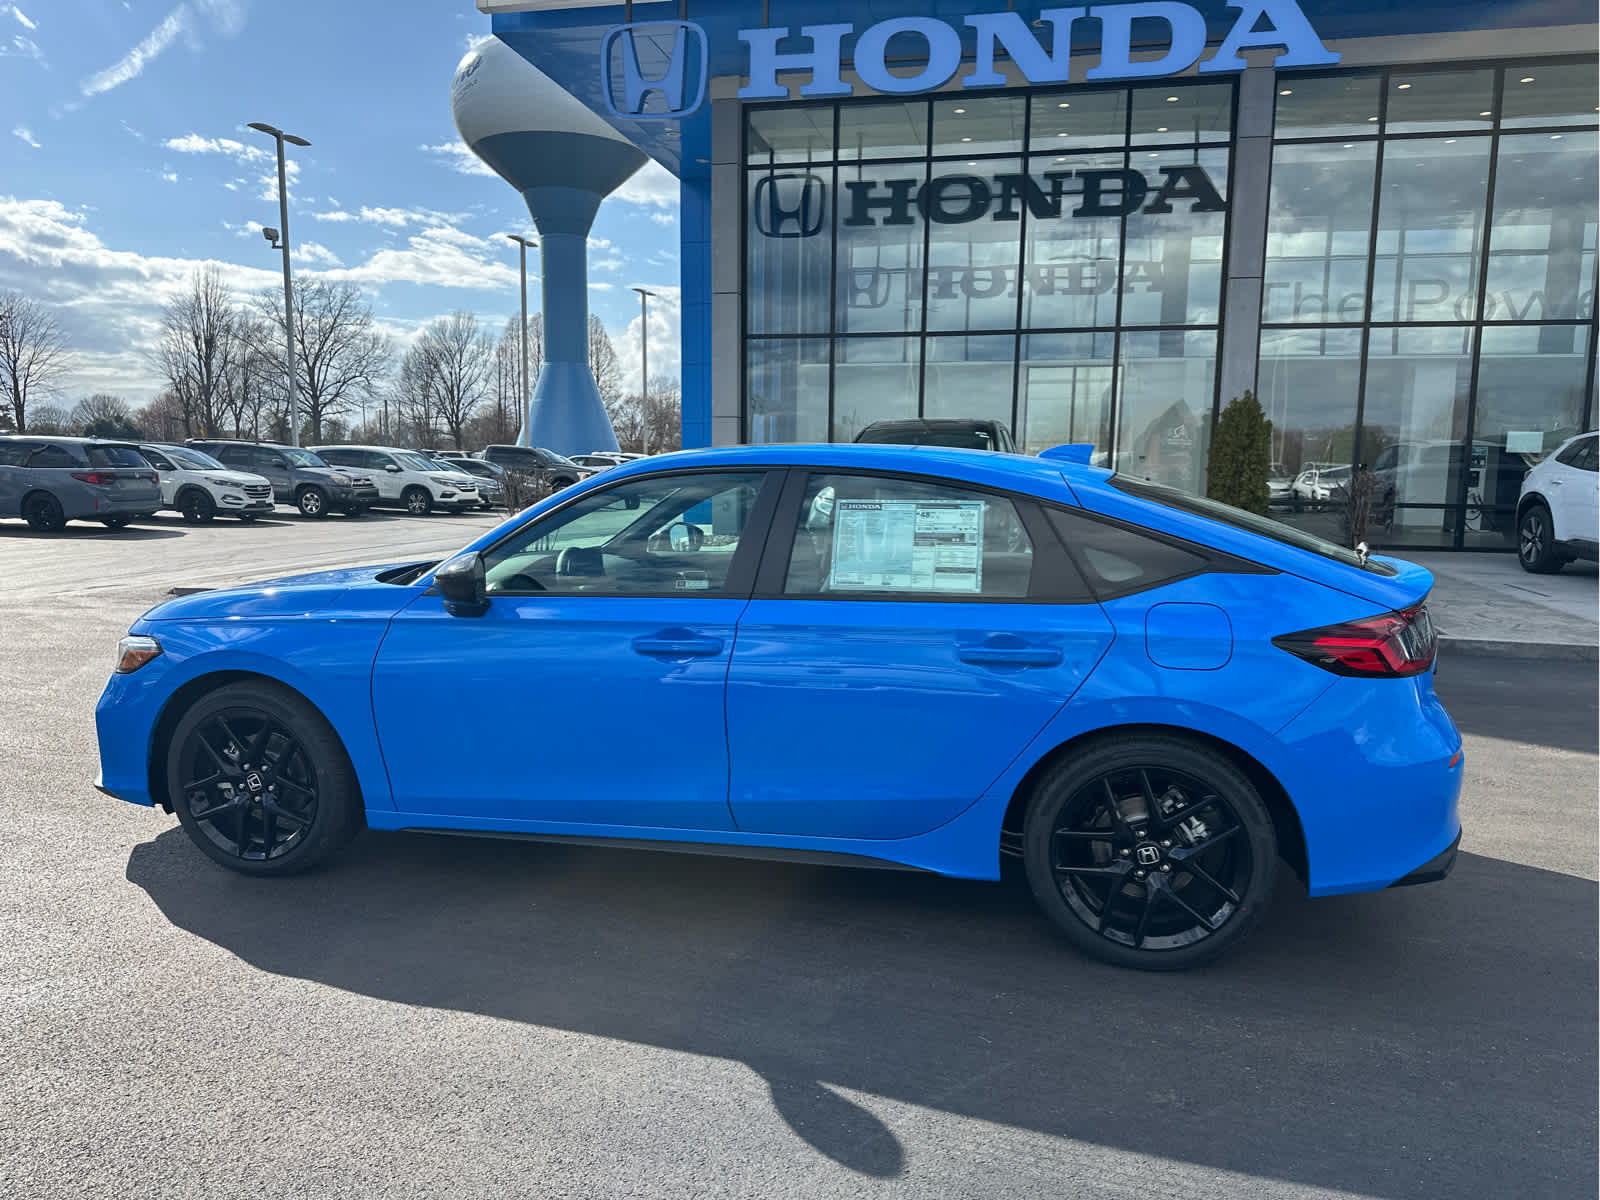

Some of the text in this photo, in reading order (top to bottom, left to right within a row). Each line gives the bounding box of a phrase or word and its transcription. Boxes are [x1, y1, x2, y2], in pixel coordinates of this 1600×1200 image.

[737, 0, 1342, 99] HONDA
[844, 164, 1227, 226] HONDA
[907, 261, 1162, 300] HONDA
